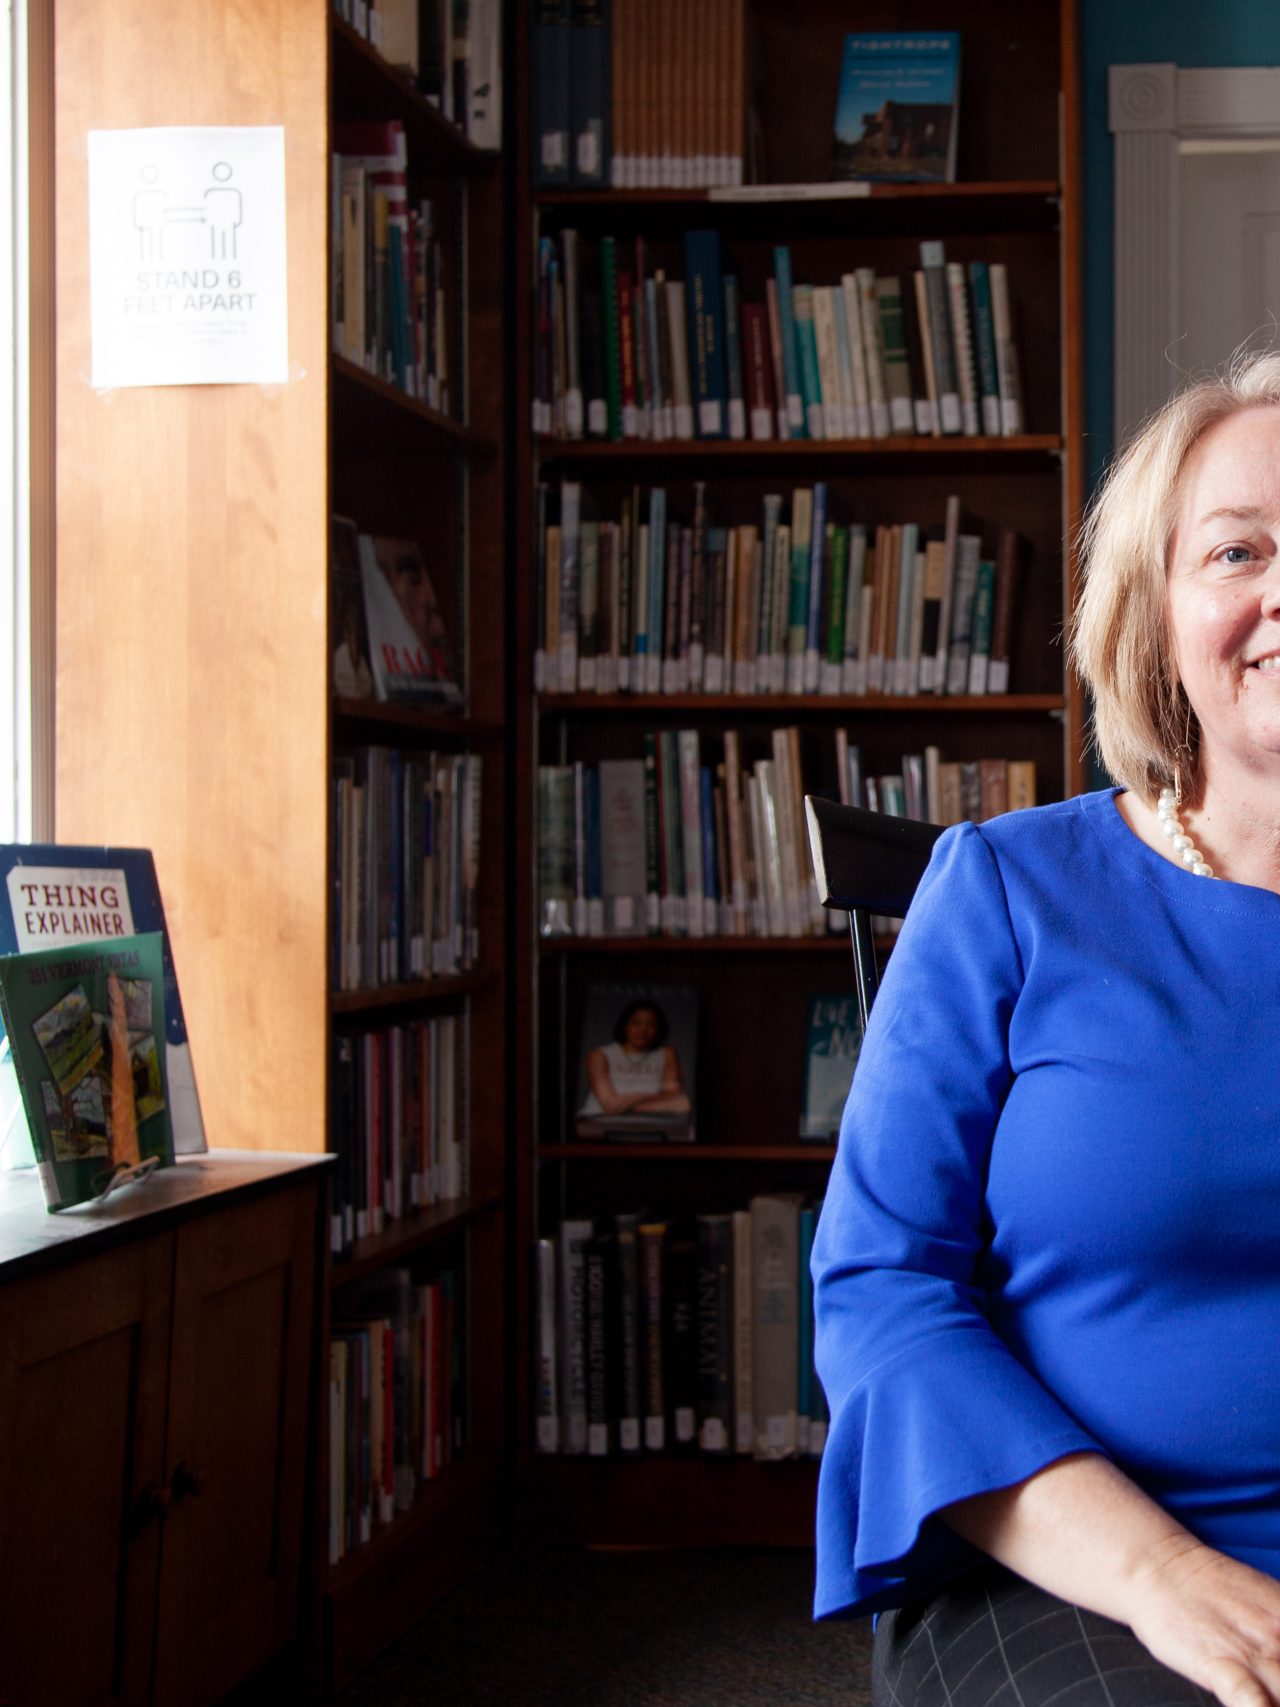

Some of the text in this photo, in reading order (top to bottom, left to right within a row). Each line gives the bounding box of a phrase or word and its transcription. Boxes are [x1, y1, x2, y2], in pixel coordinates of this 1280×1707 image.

[137, 269, 242, 291] STAND 6
[124, 293, 258, 316] FEET APART
[21, 884, 119, 909] THING
[25, 912, 125, 935] EXPLAINER
